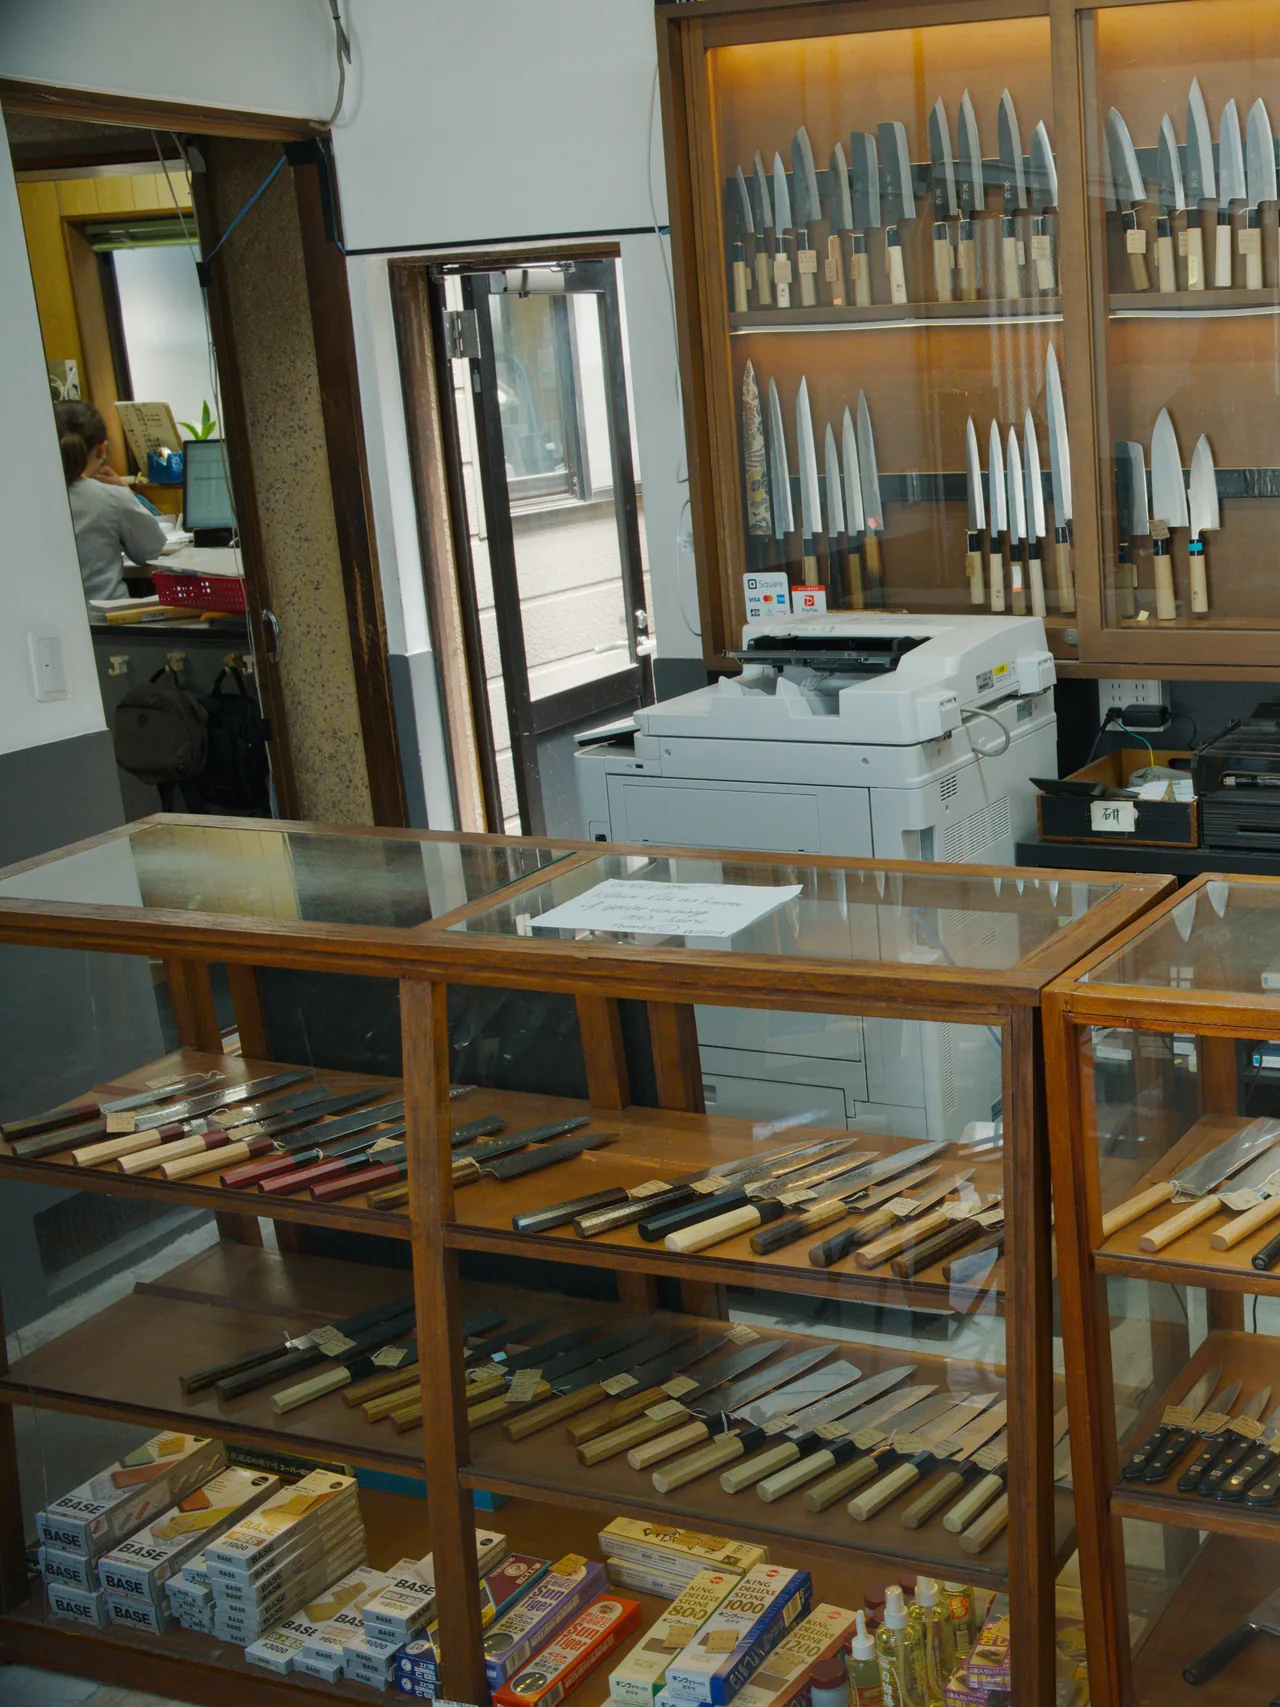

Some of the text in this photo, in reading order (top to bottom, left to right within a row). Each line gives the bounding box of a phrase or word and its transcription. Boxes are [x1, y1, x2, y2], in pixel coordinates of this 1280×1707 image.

[758, 580, 784, 588] Square
[56, 1498, 105, 1515] BASE
[239, 1520, 282, 1536] BASE
[43, 1528, 81, 1547] BASE
[222, 1540, 249, 1551] #1000
[118, 1543, 168, 1561] BASE
[217, 1554, 233, 1564] BASE
[46, 1562, 82, 1583] BASE
[220, 1570, 236, 1579] BASE
[105, 1574, 144, 1595] BASE
[225, 1583, 242, 1592] BASE
[394, 1579, 436, 1596] BASE
[743, 1578, 772, 1588] KING
[533, 1585, 565, 1602] Sun
[688, 1585, 715, 1594] KING
[738, 1585, 778, 1596] DELUXE
[225, 1592, 242, 1600] BASE
[683, 1592, 721, 1603] DELUXE
[732, 1591, 765, 1602] STONE
[55, 1599, 93, 1618] BASE
[229, 1605, 246, 1613] BASE
[520, 1596, 553, 1613] Tiger
[677, 1599, 710, 1609] STONE
[723, 1599, 766, 1615] 1000
[113, 1605, 152, 1625] BASE
[667, 1605, 708, 1620] 800
[228, 1615, 244, 1624] BASE
[334, 1613, 364, 1628] BAS
[375, 1615, 392, 1624] BASE
[804, 1618, 831, 1631] KING
[226, 1623, 242, 1632] BASE
[280, 1619, 319, 1637] BASE
[567, 1622, 600, 1640] Sun
[798, 1625, 836, 1640] DELUXE
[230, 1635, 246, 1643] BASE
[378, 1629, 396, 1638] BASE
[791, 1632, 823, 1645] STONE
[262, 1642, 288, 1654] #3000
[553, 1634, 588, 1652] Tiger
[780, 1639, 821, 1657] 1200
[316, 1651, 332, 1660] BASE
[356, 1653, 372, 1662] BASE
[305, 1665, 320, 1674] BASE
[362, 1664, 378, 1672] BASE
[356, 1673, 371, 1682] BASE
